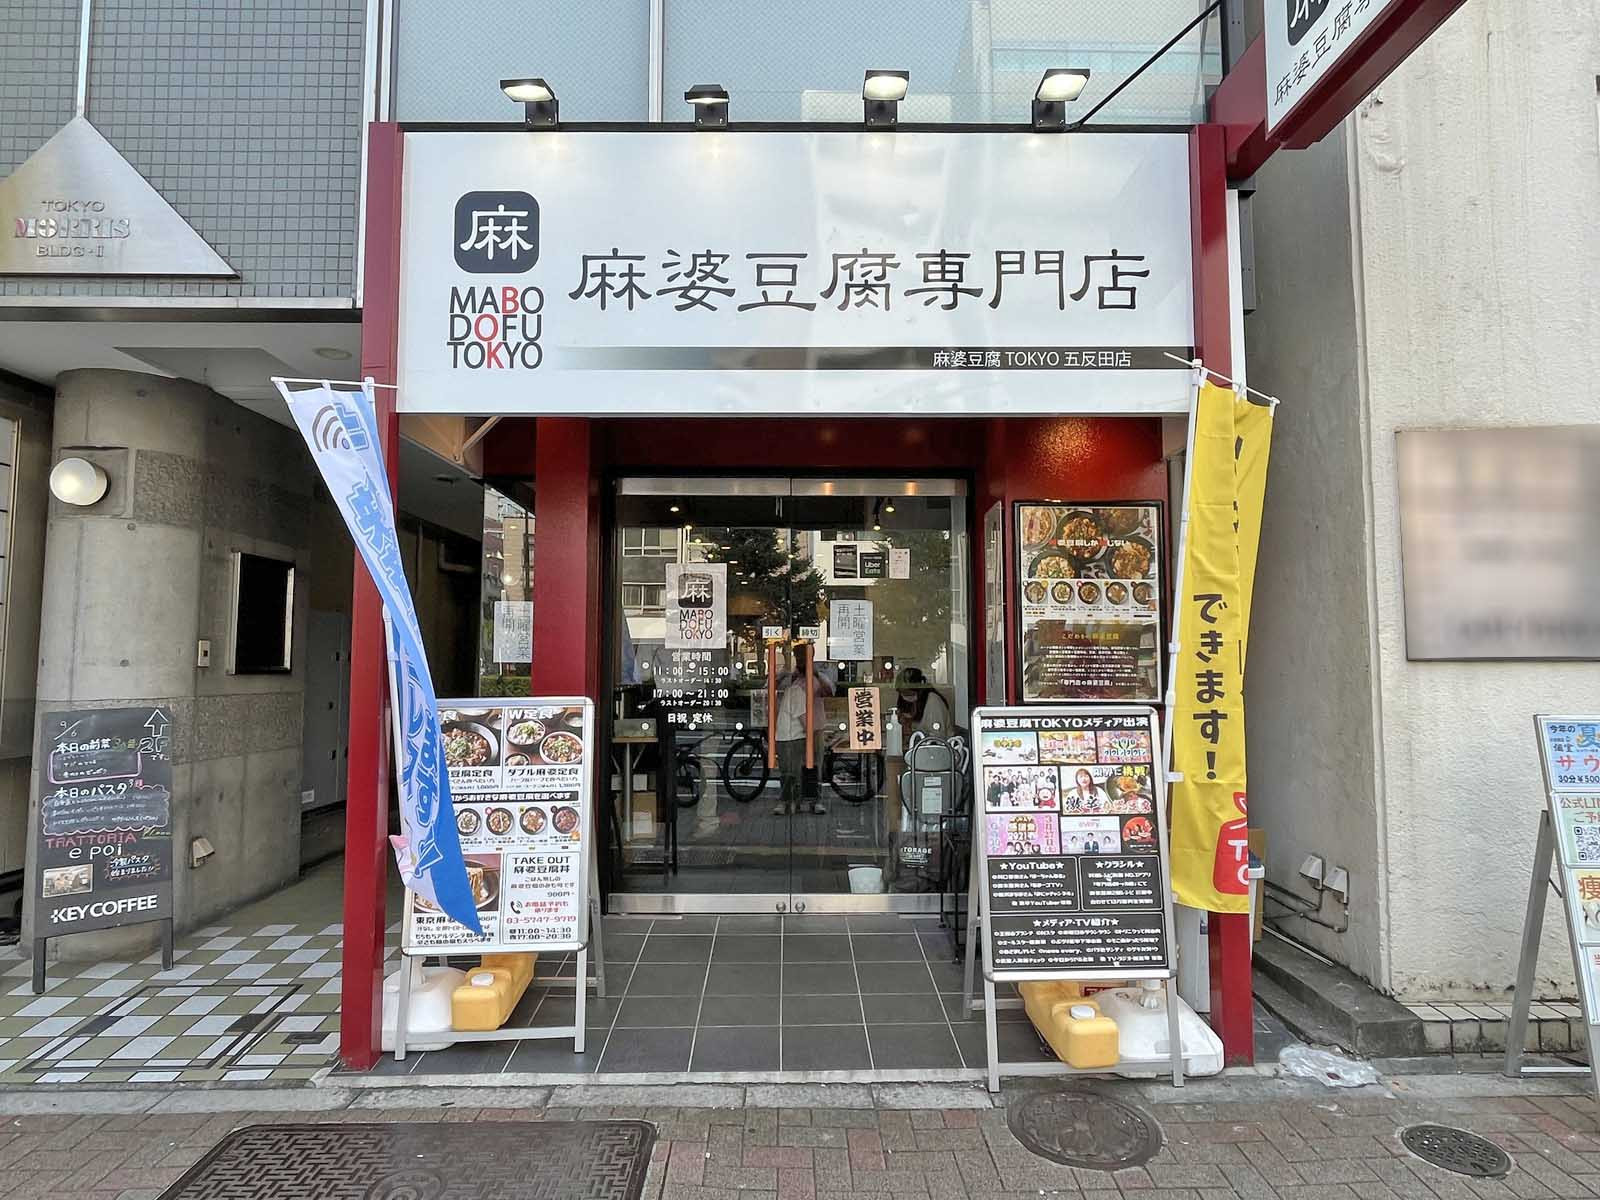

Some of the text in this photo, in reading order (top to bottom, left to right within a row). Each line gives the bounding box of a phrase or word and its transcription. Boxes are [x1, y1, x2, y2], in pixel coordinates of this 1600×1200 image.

[41, 200, 105, 212] TOKYO
[15, 218, 131, 239] MORRIS
[459, 204, 534, 260] 麻
[568, 247, 1150, 312] 麻婆豆腐専門店
[449, 286, 544, 314] MABO
[450, 314, 542, 342] DOFU
[447, 341, 543, 369] TOKYO
[933, 350, 1132, 368] 麻婆豆腐 TOKYO 五反田店
[681, 579, 711, 603] 麻
[679, 609, 714, 620] MABO
[679, 629, 713, 640] TOKYO
[764, 628, 780, 638] 引く
[672, 652, 712, 662] 営業時間
[667, 713, 713, 723] 日祝 定休
[855, 690, 875, 746] 営業中
[56, 738, 112, 754] 本日の前菜
[140, 737, 169, 753] 2F
[450, 768, 493, 778] 豆腐定食
[55, 782, 127, 798] 本日のパスタ
[1574, 811, 1600, 823] ご予
[46, 832, 137, 849] TRATTORIA
[512, 856, 571, 865] TAKE OUT
[1008, 862, 1056, 870] YouTube
[1104, 860, 1136, 869] クラシル
